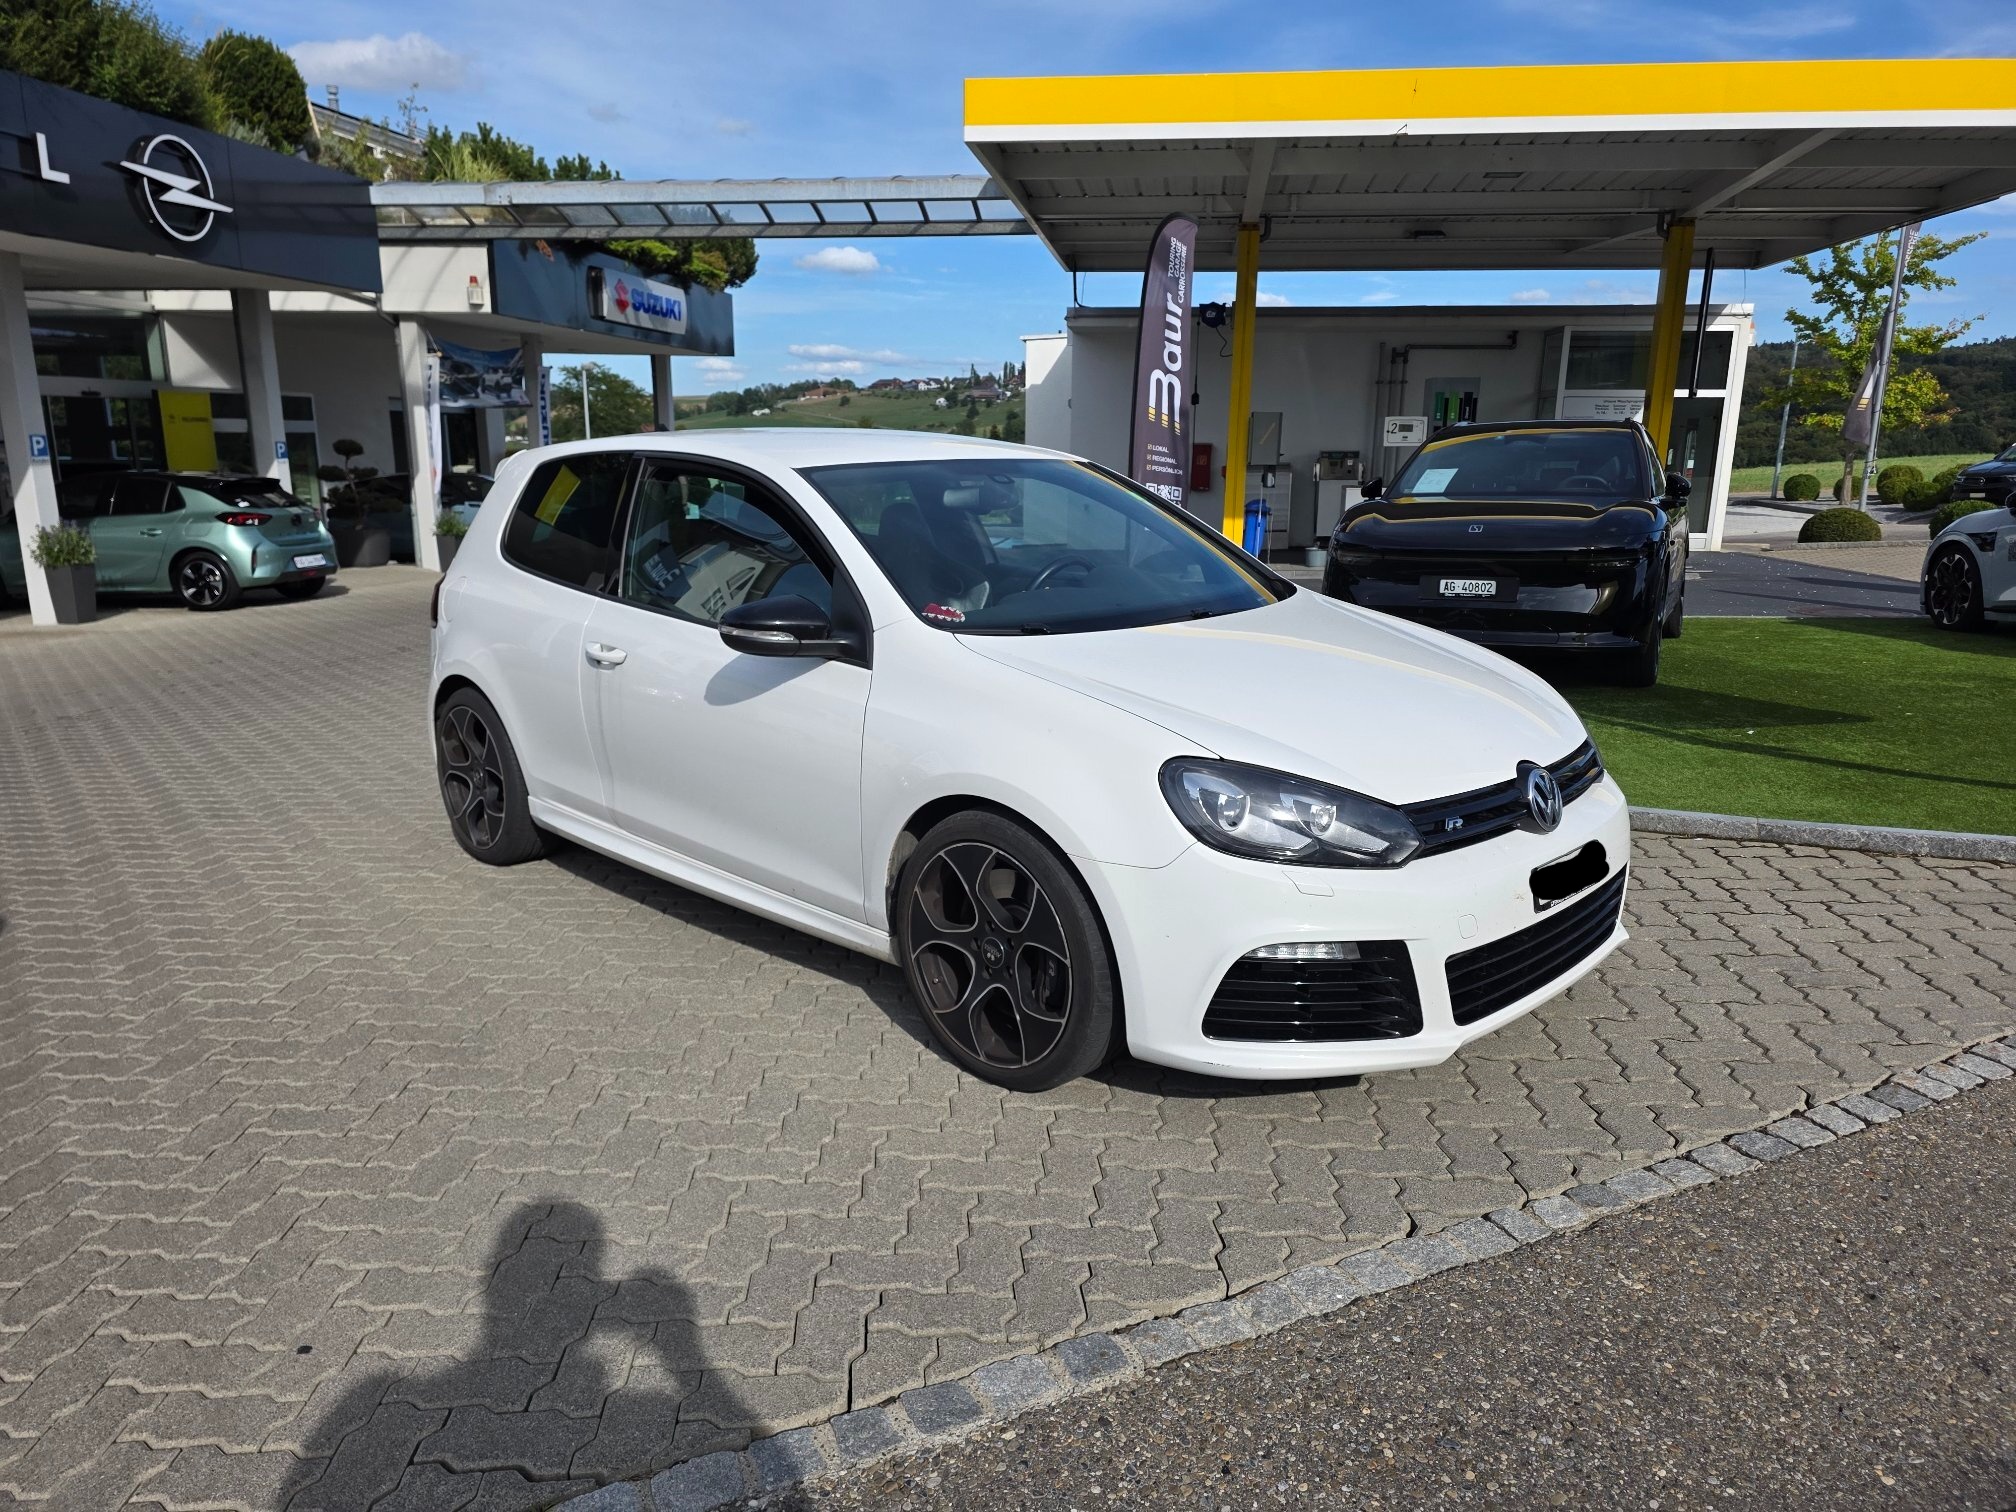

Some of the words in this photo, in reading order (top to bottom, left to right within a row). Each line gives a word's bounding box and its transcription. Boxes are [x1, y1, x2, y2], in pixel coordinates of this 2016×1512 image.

[1168, 236, 1177, 277] TOURING
[1174, 239, 1182, 278] GARAGE
[1177, 243, 1187, 304] CARROSSERIE
[631, 288, 682, 322] SUZUKI
[1149, 292, 1182, 435] Baur
[1390, 422, 1398, 434] 2
[32, 436, 45, 456] P
[277, 442, 286, 457] P
[1152, 445, 1169, 453] LOKAL
[1152, 454, 1177, 464] REGIONAL
